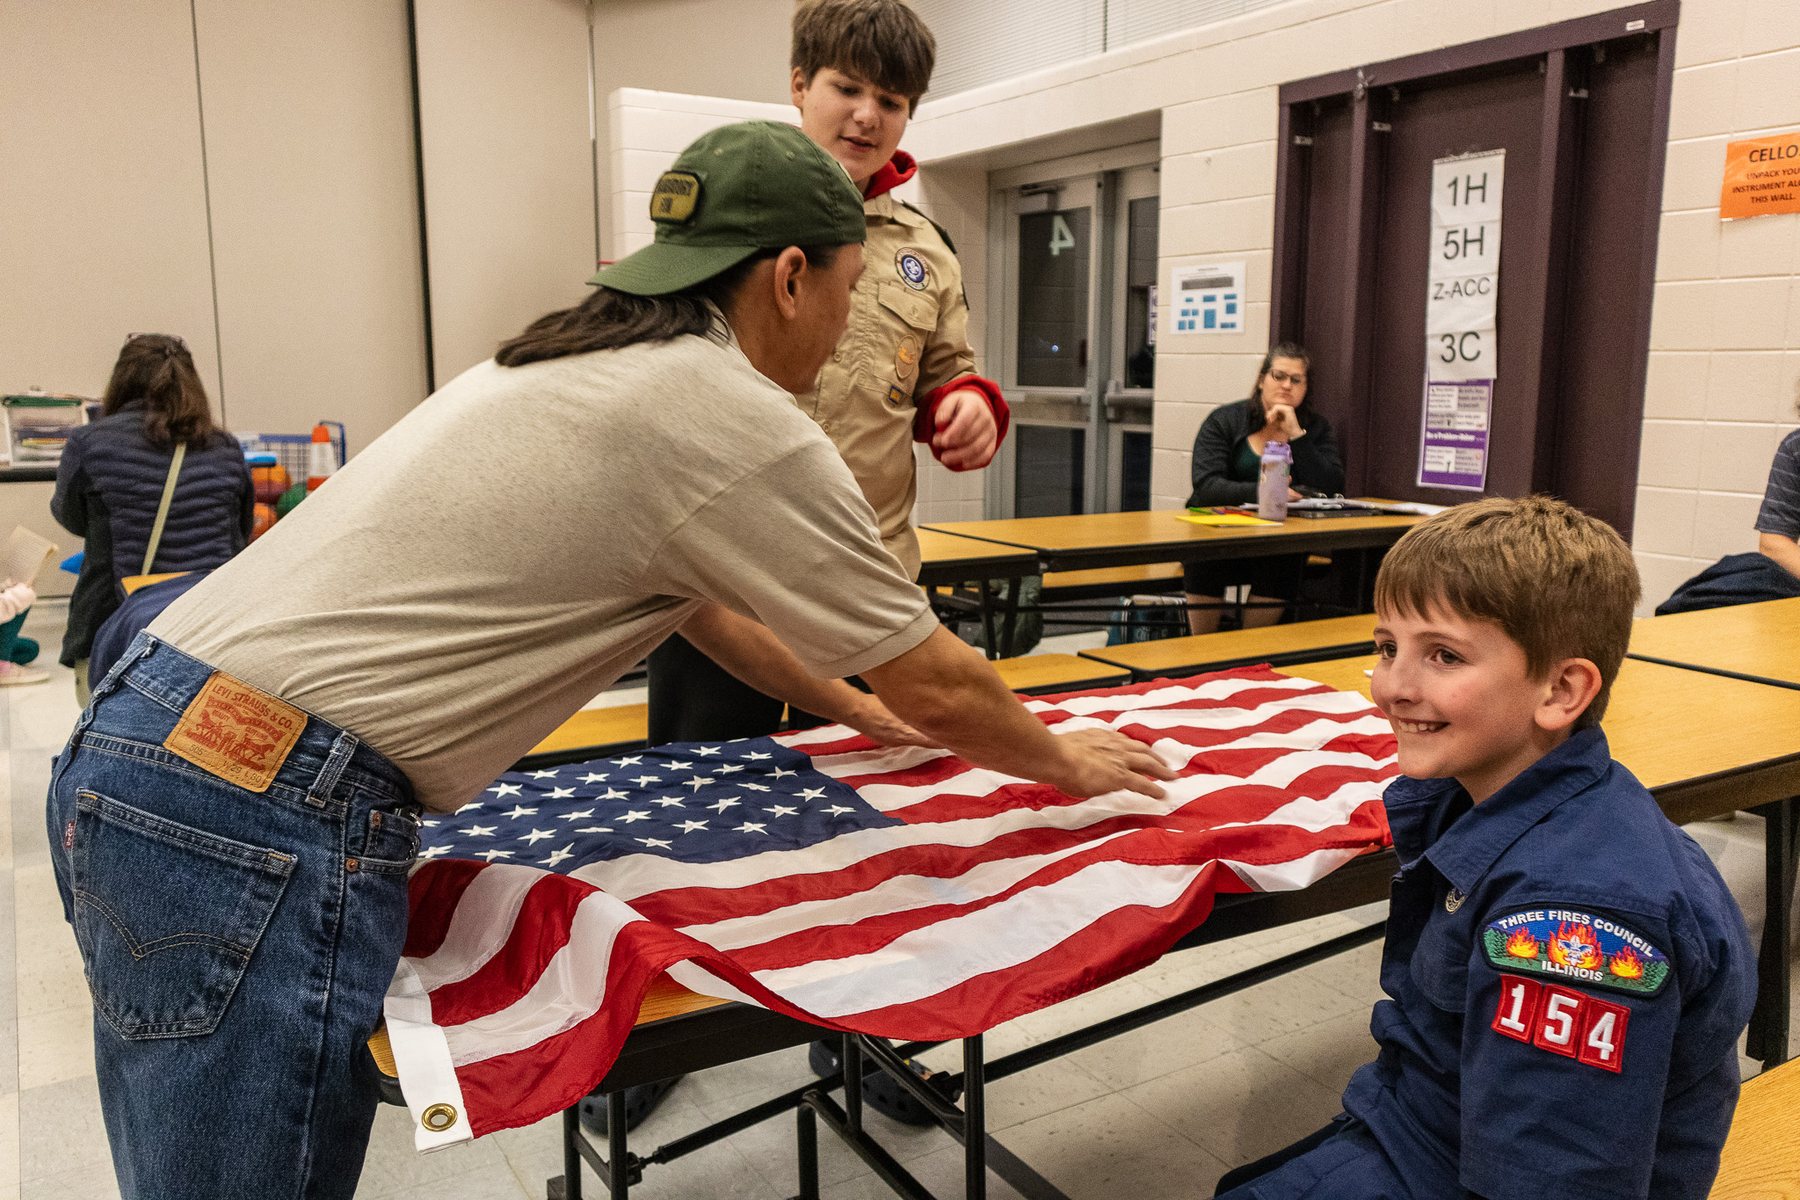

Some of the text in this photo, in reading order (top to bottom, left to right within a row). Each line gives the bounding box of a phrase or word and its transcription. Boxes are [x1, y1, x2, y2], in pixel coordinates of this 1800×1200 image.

[1749, 145, 1800, 162] CELLO
[1447, 172, 1487, 206] 1H
[1733, 181, 1785, 193] INSTRUMENT
[1750, 196, 1768, 204] THIS
[1443, 226, 1484, 260] 5H
[1433, 277, 1490, 301] Z-ACC
[1440, 331, 1481, 363] 3C
[212, 684, 232, 699] LEVI
[231, 692, 271, 717] STRAUSS
[269, 712, 279, 722] &
[278, 716, 293, 730] CO.
[1499, 910, 1654, 958] THREE FIRES COUNCIL
[1541, 960, 1604, 982] ILLINOIS
